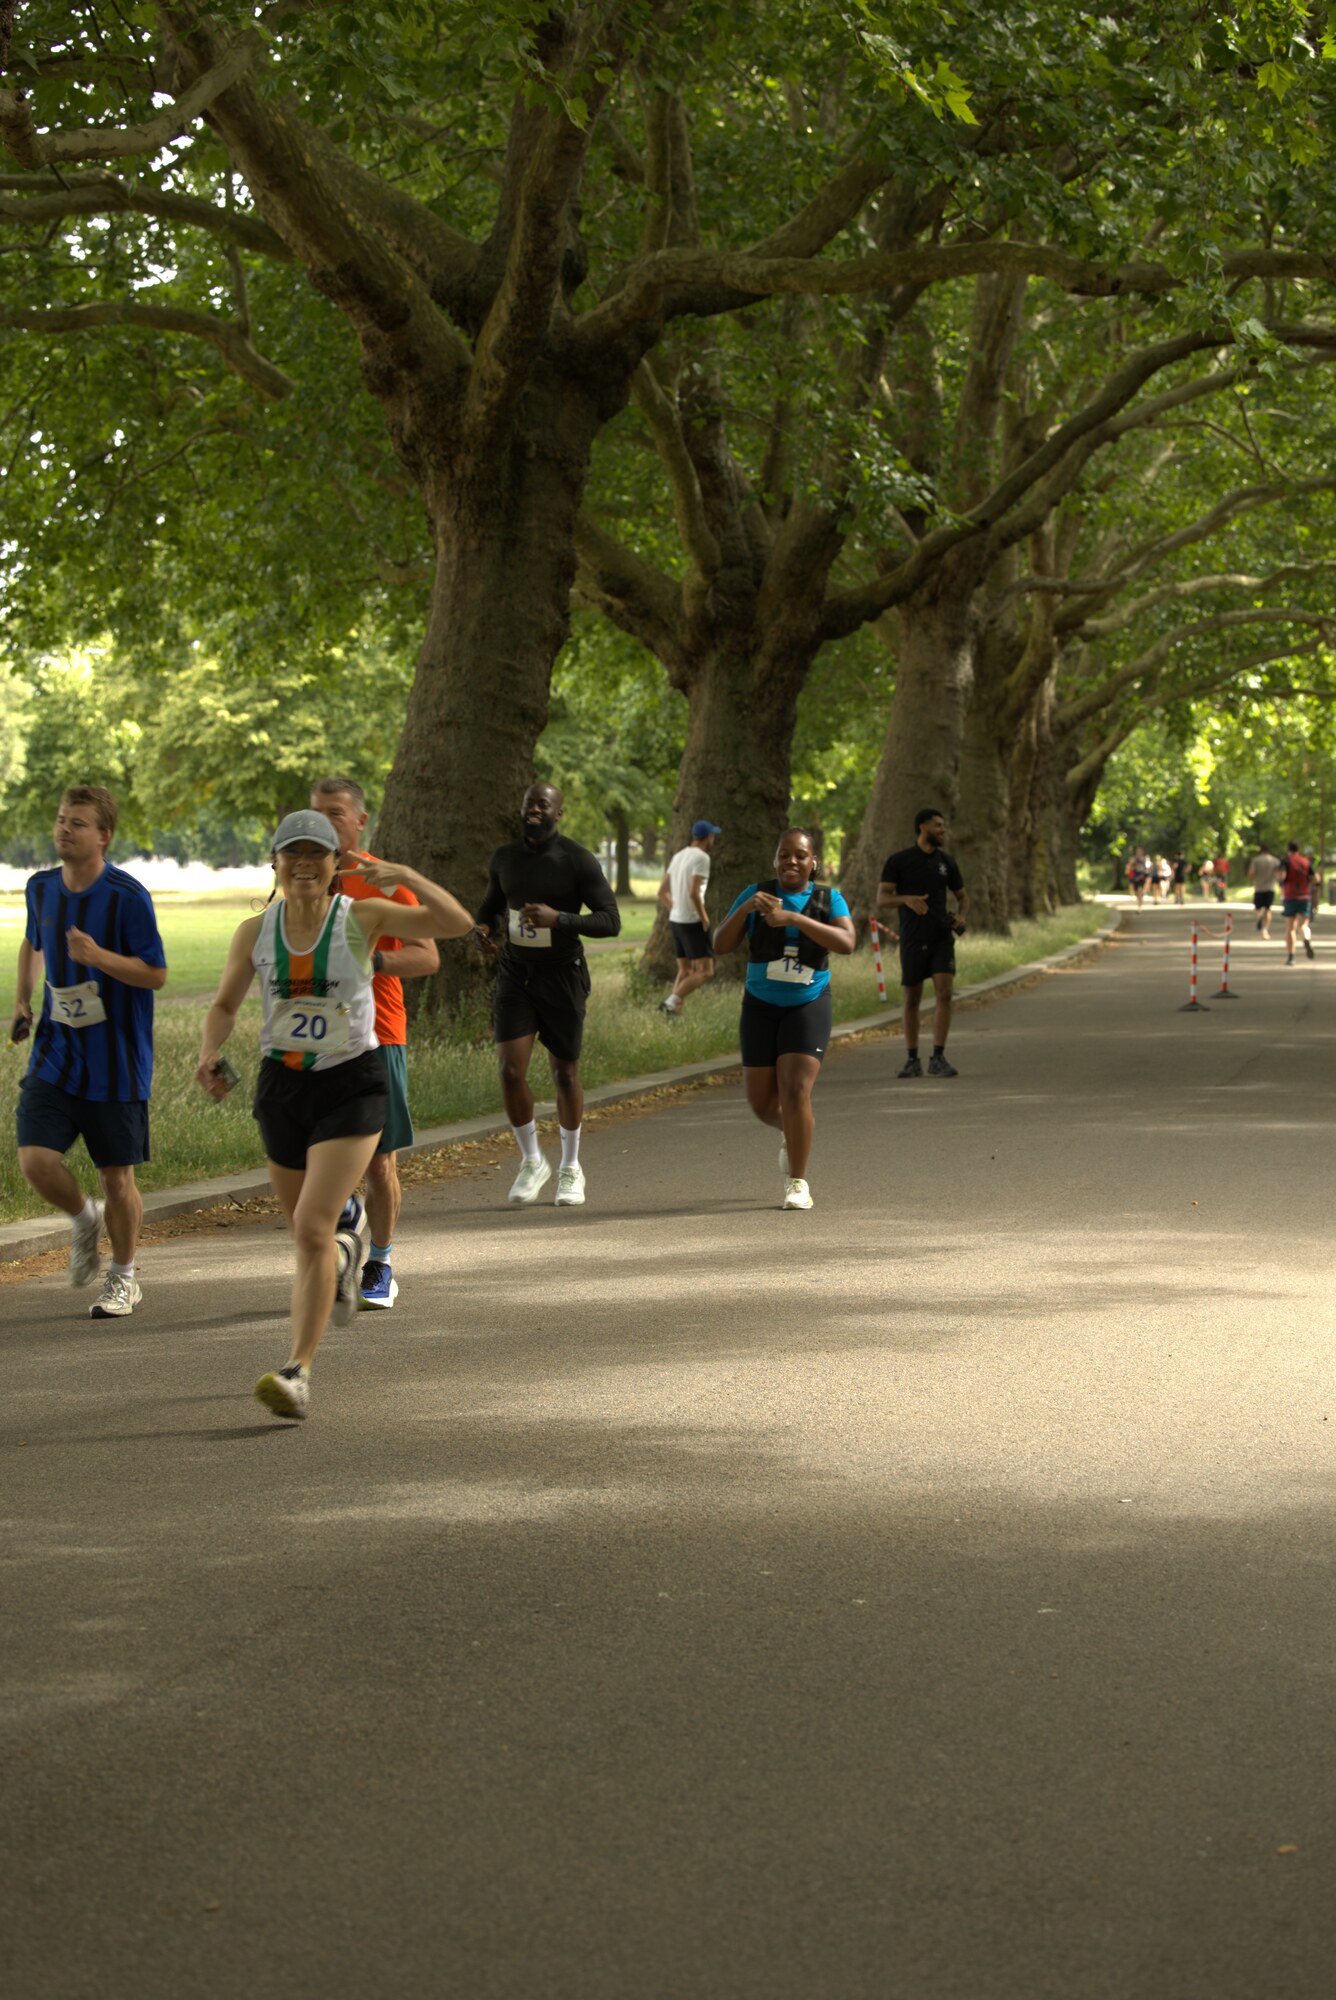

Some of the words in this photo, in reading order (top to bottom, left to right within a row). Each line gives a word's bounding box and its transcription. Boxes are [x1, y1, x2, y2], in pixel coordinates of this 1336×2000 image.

[782, 957, 804, 974] 14
[59, 998, 87, 1018] 52
[291, 1013, 326, 1040] 20
